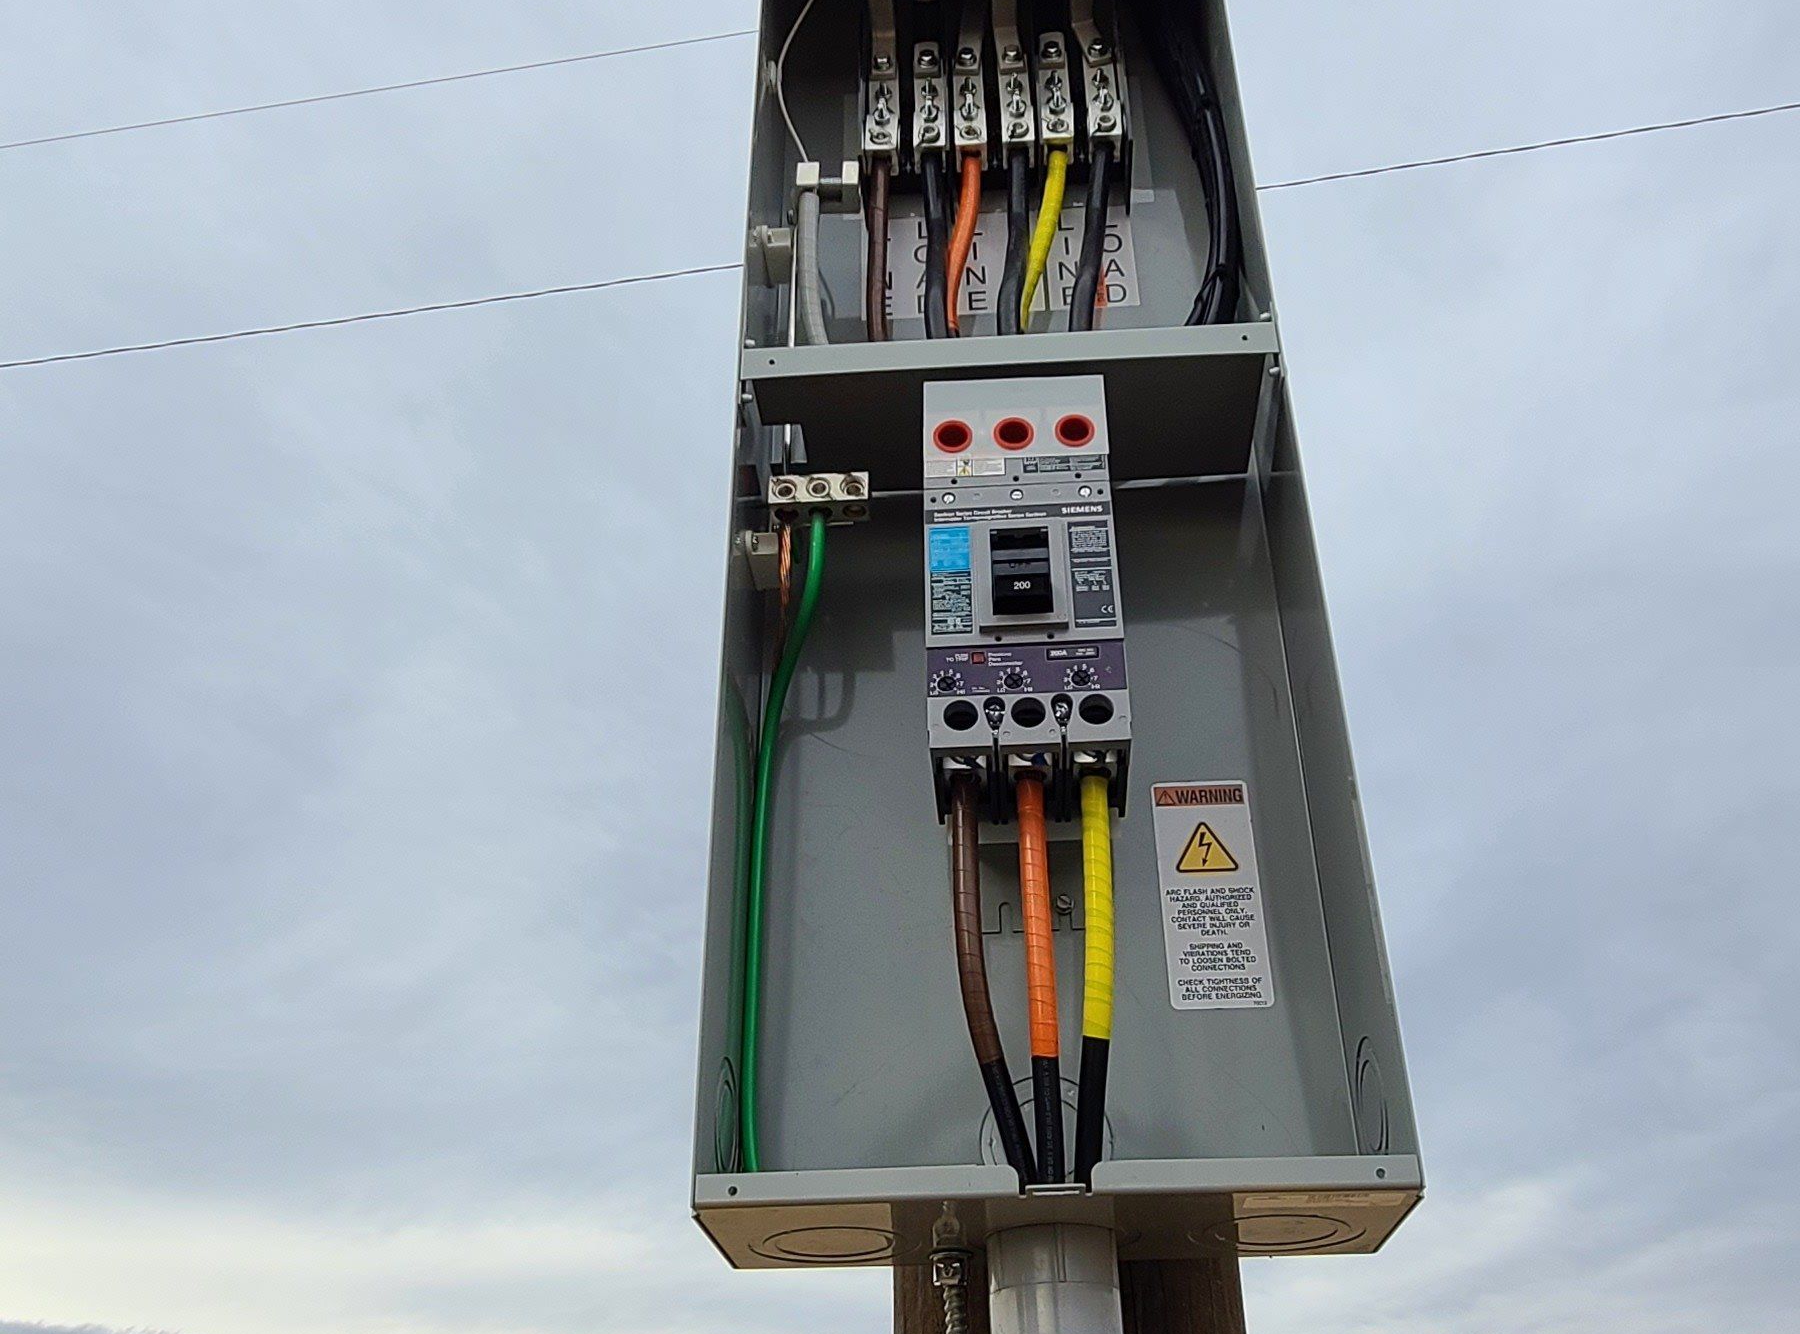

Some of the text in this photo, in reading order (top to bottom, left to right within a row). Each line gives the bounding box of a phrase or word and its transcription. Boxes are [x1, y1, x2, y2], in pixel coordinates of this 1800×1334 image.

[1061, 505, 1103, 514] SIEMENS
[1013, 581, 1031, 590] 200
[1101, 605, 1114, 613] CE
[1175, 788, 1243, 804] WARNING
[1191, 964, 1246, 972] CONNECTIONS
